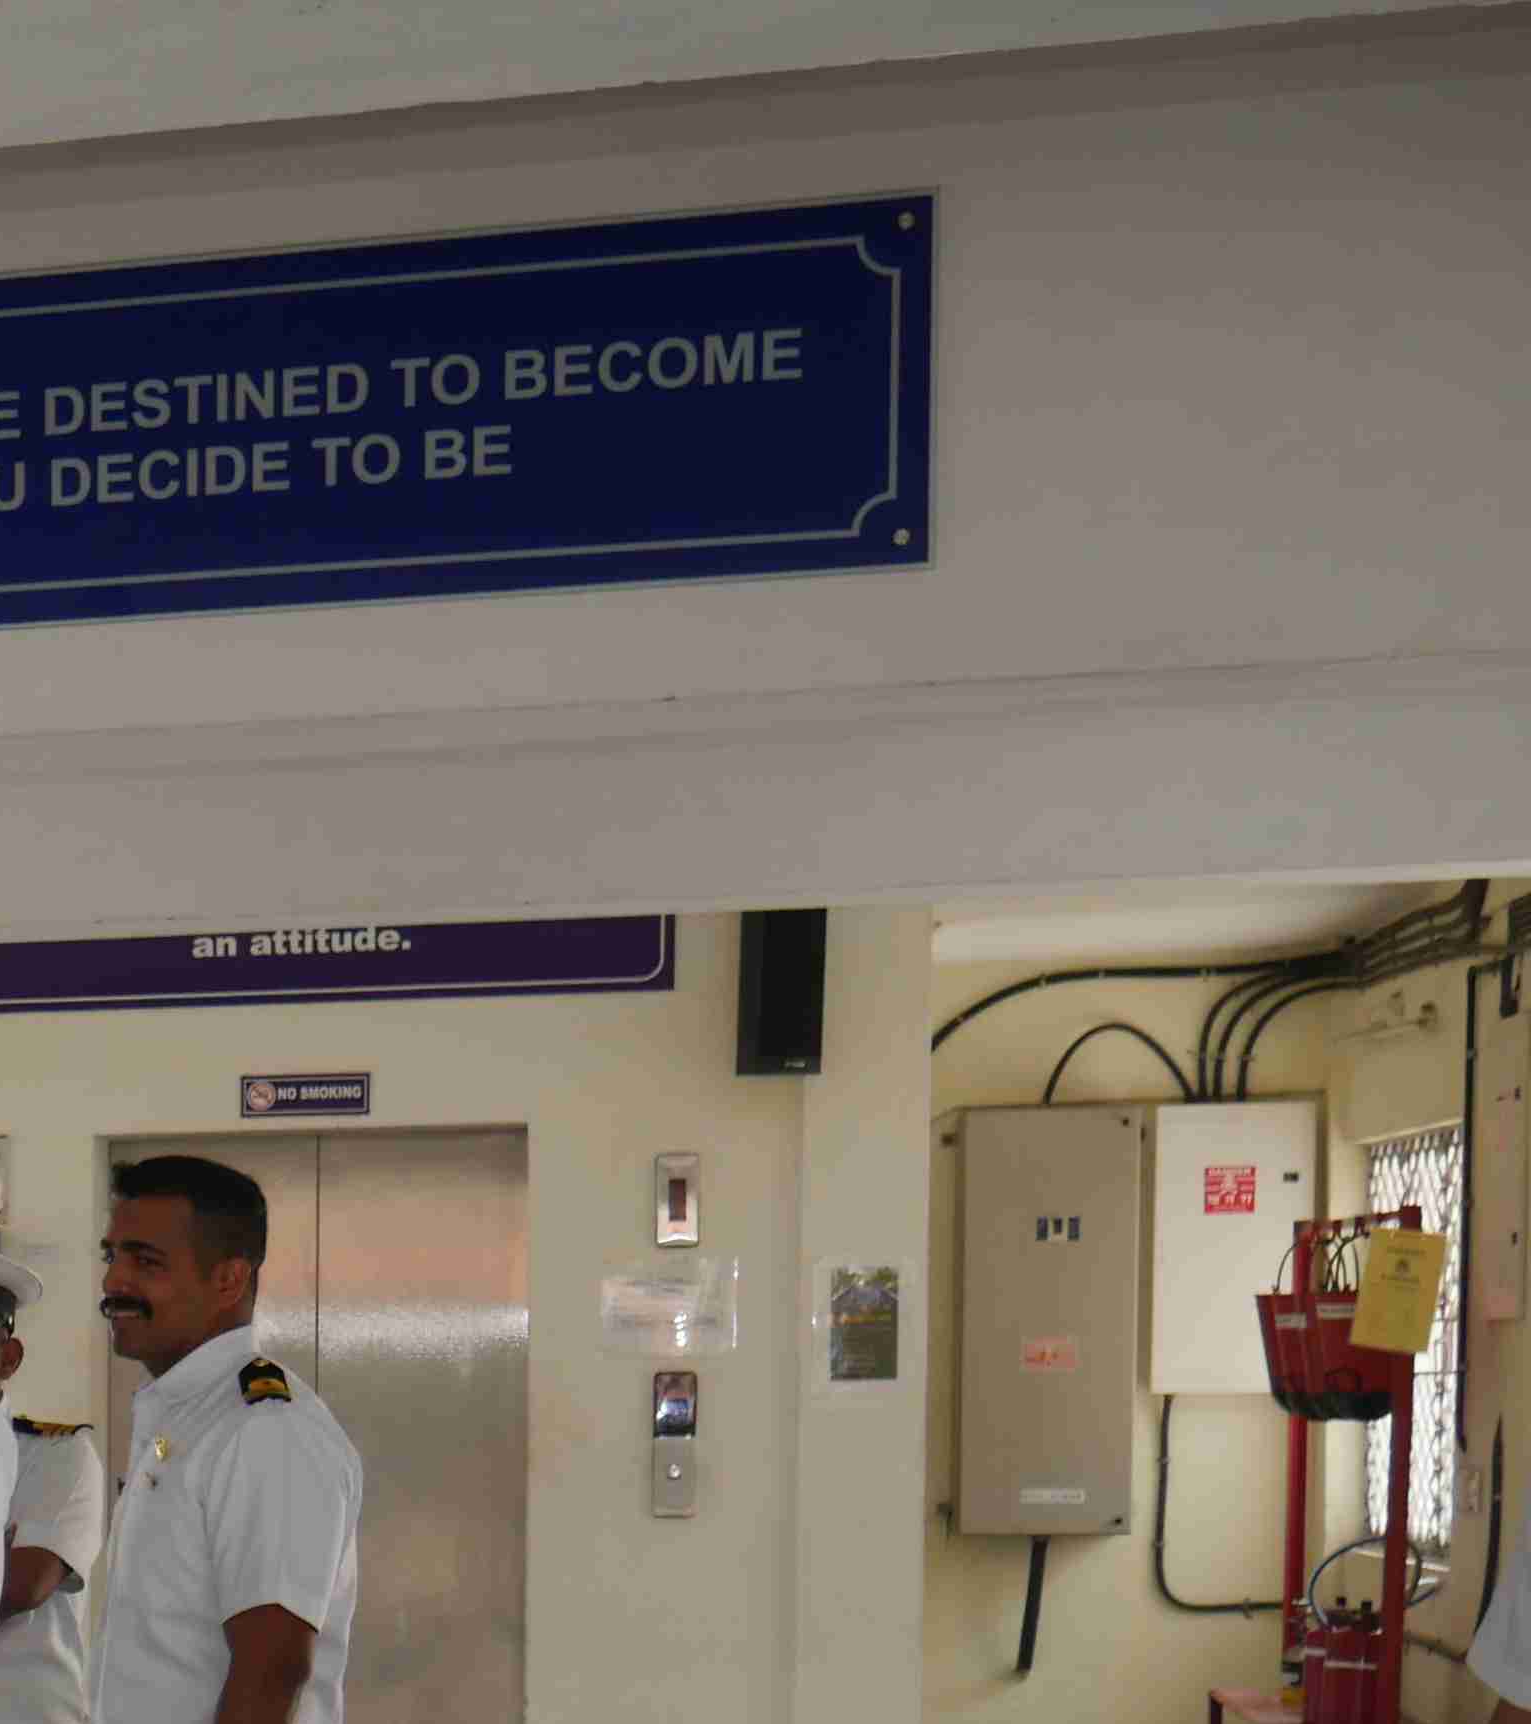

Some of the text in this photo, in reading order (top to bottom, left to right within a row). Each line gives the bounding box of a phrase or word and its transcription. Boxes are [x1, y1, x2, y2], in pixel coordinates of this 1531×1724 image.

[44, 364, 369, 436] DESTINED
[391, 354, 480, 407] TO
[505, 328, 802, 401] BECOME
[50, 442, 290, 506] DECIDE
[312, 434, 401, 486] TO
[424, 425, 512, 480] BE
[191, 926, 412, 958] an attitude.
[277, 1083, 362, 1101] NO SMOKING
